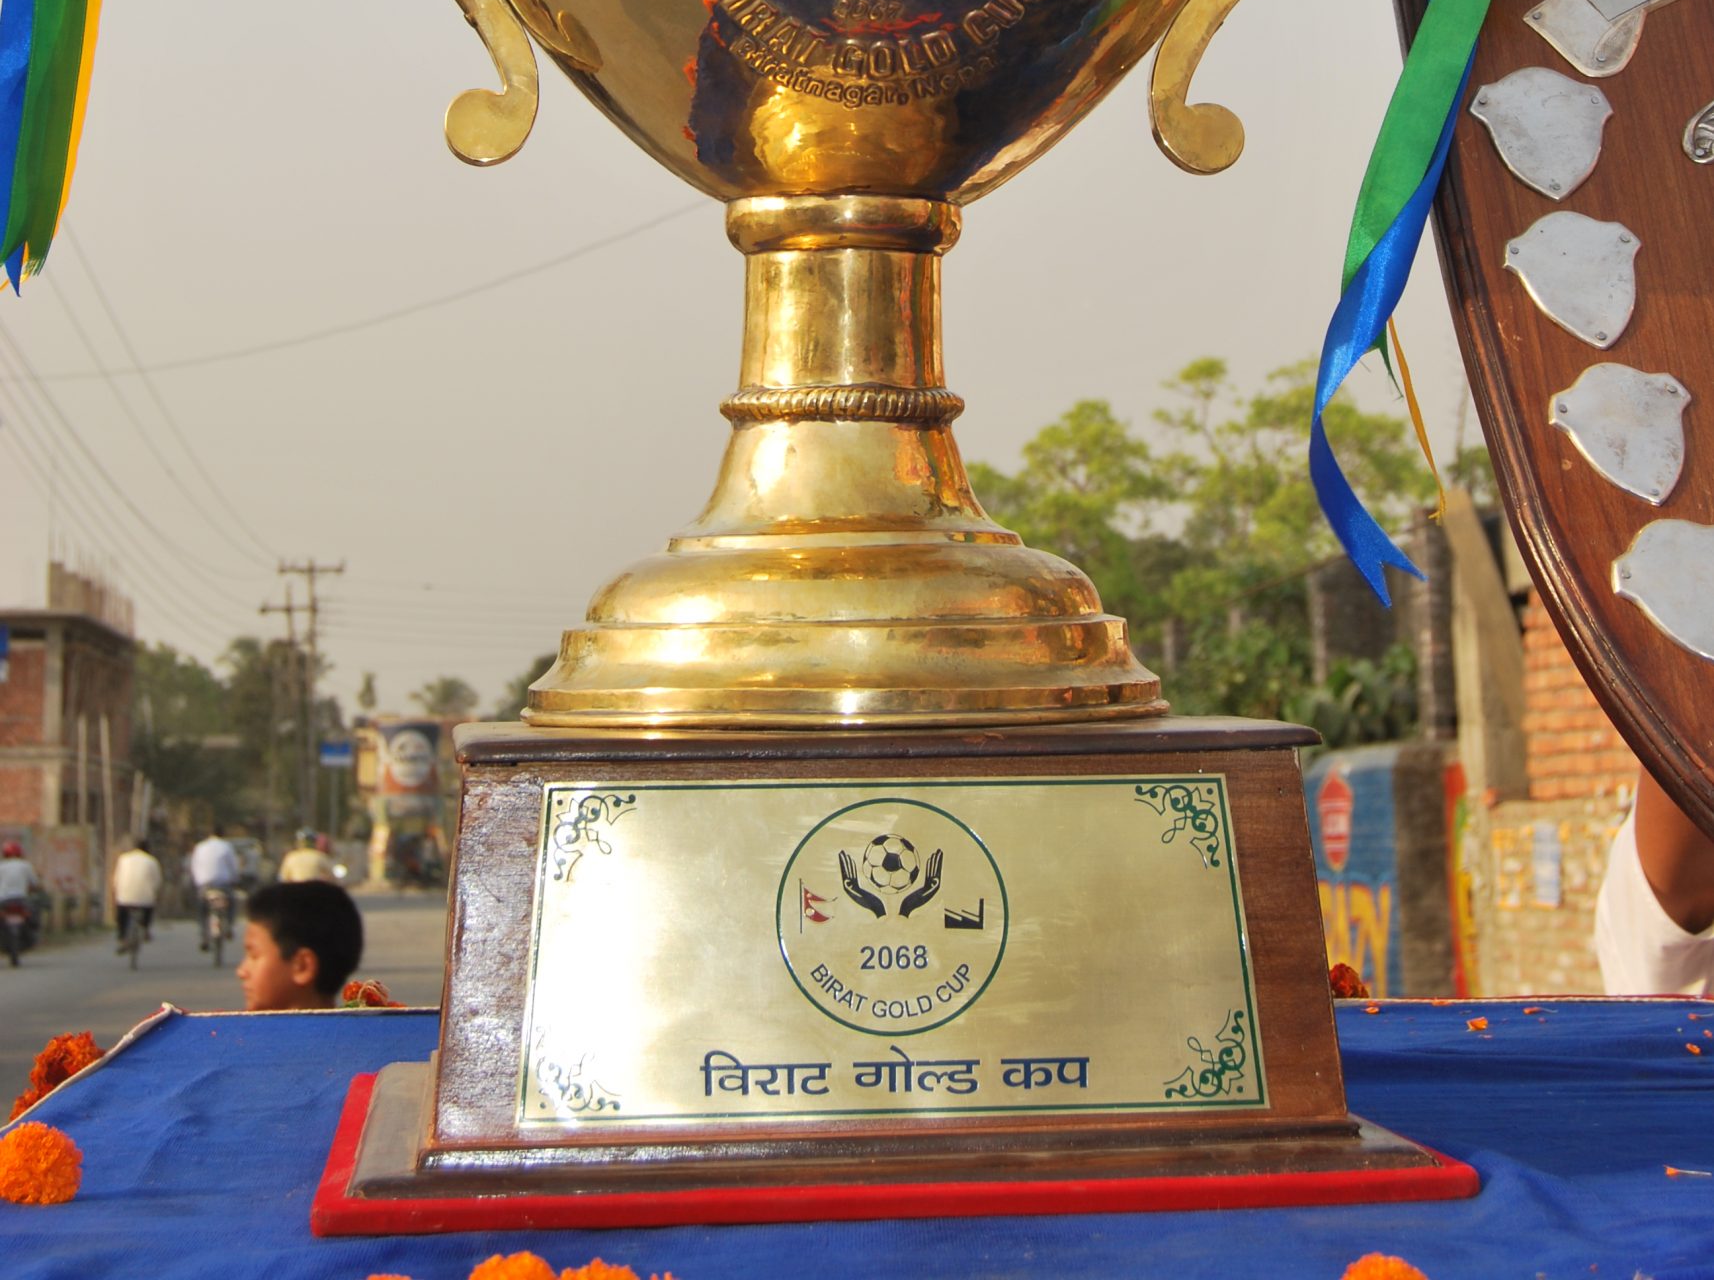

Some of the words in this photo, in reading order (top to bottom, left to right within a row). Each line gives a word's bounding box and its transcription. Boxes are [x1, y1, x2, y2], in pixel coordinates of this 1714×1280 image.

[831, 30, 960, 79] GOLD
[911, 48, 999, 97] Nepa
[859, 945, 930, 970] 2068
[810, 963, 868, 1012] BIRAT
[871, 995, 933, 1019] GOLD
[935, 963, 973, 1003] CUP
[700, 1050, 832, 1097] विराट
[852, 1044, 981, 1095] गोल्ड
[1000, 1056, 1091, 1090] कप
